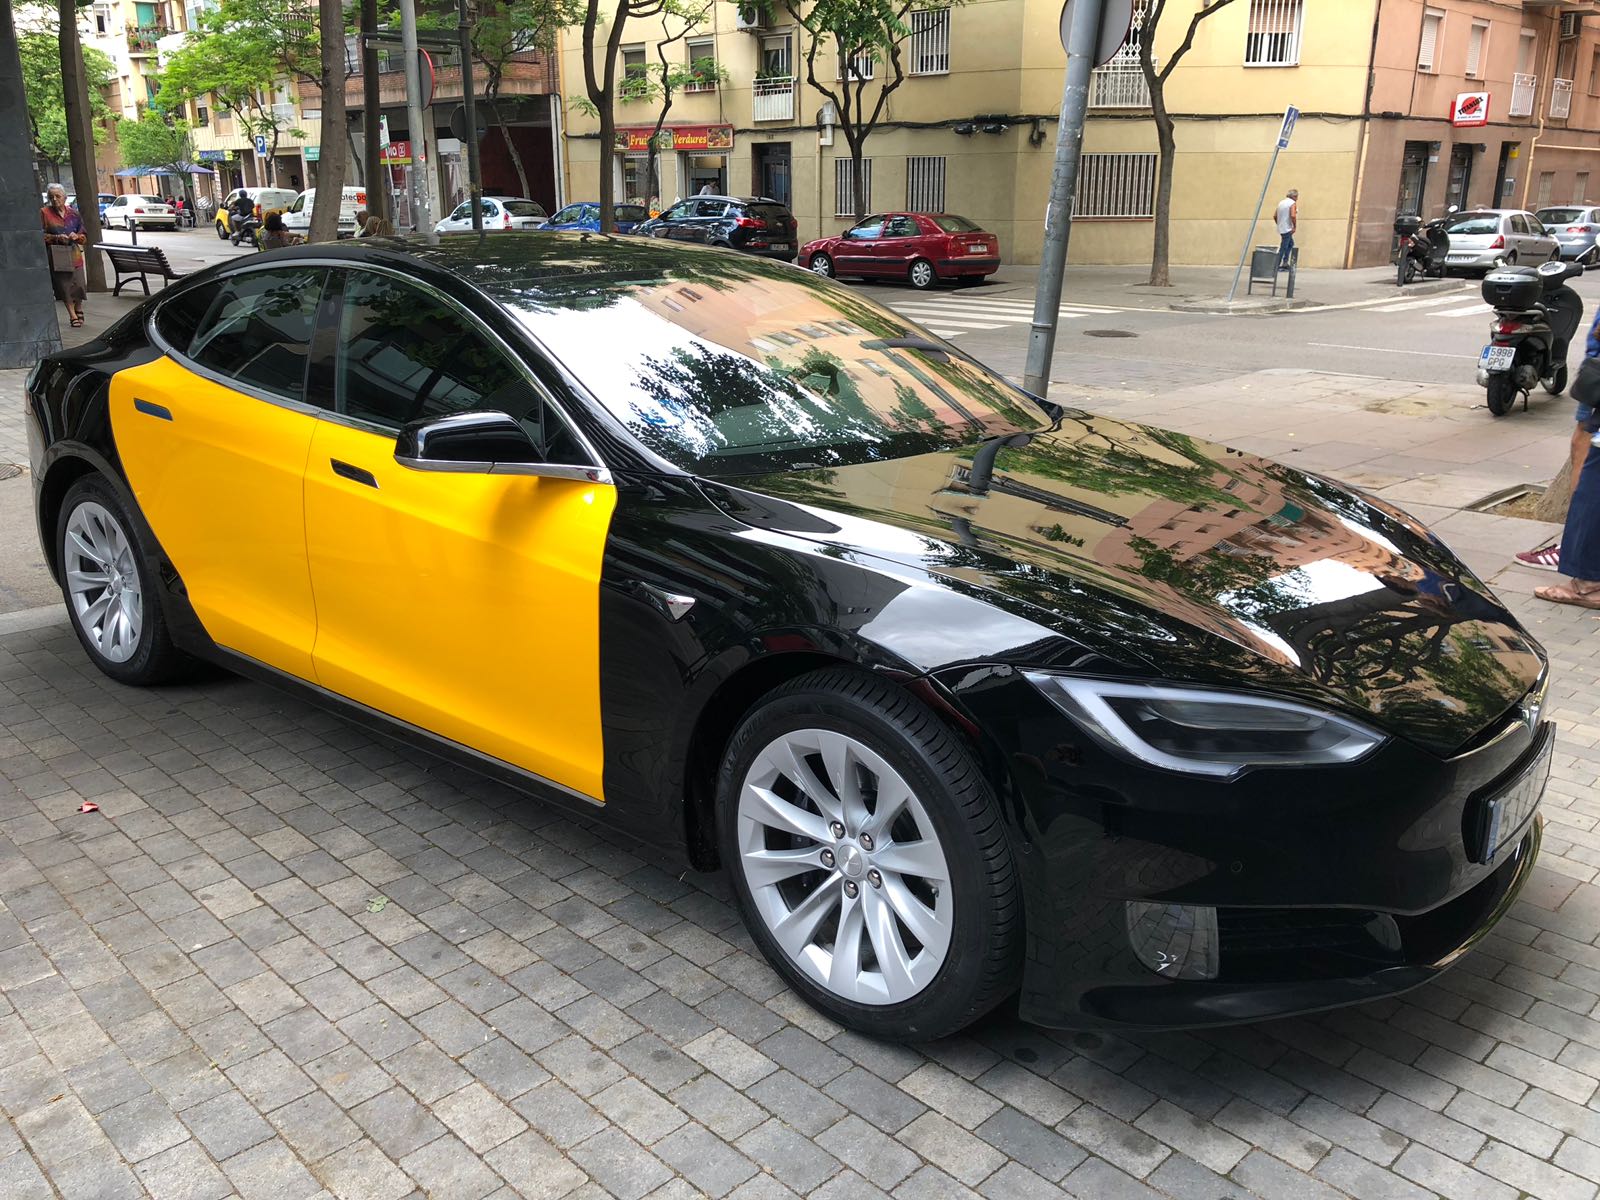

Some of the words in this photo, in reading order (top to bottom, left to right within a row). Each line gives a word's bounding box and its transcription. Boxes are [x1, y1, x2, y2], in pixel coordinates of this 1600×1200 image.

[1458, 97, 1484, 115] TITANLUX
[257, 137, 263, 151] P
[673, 133, 707, 144] Verdures
[1491, 348, 1514, 357] 5998
[1488, 358, 1505, 367] GPG
